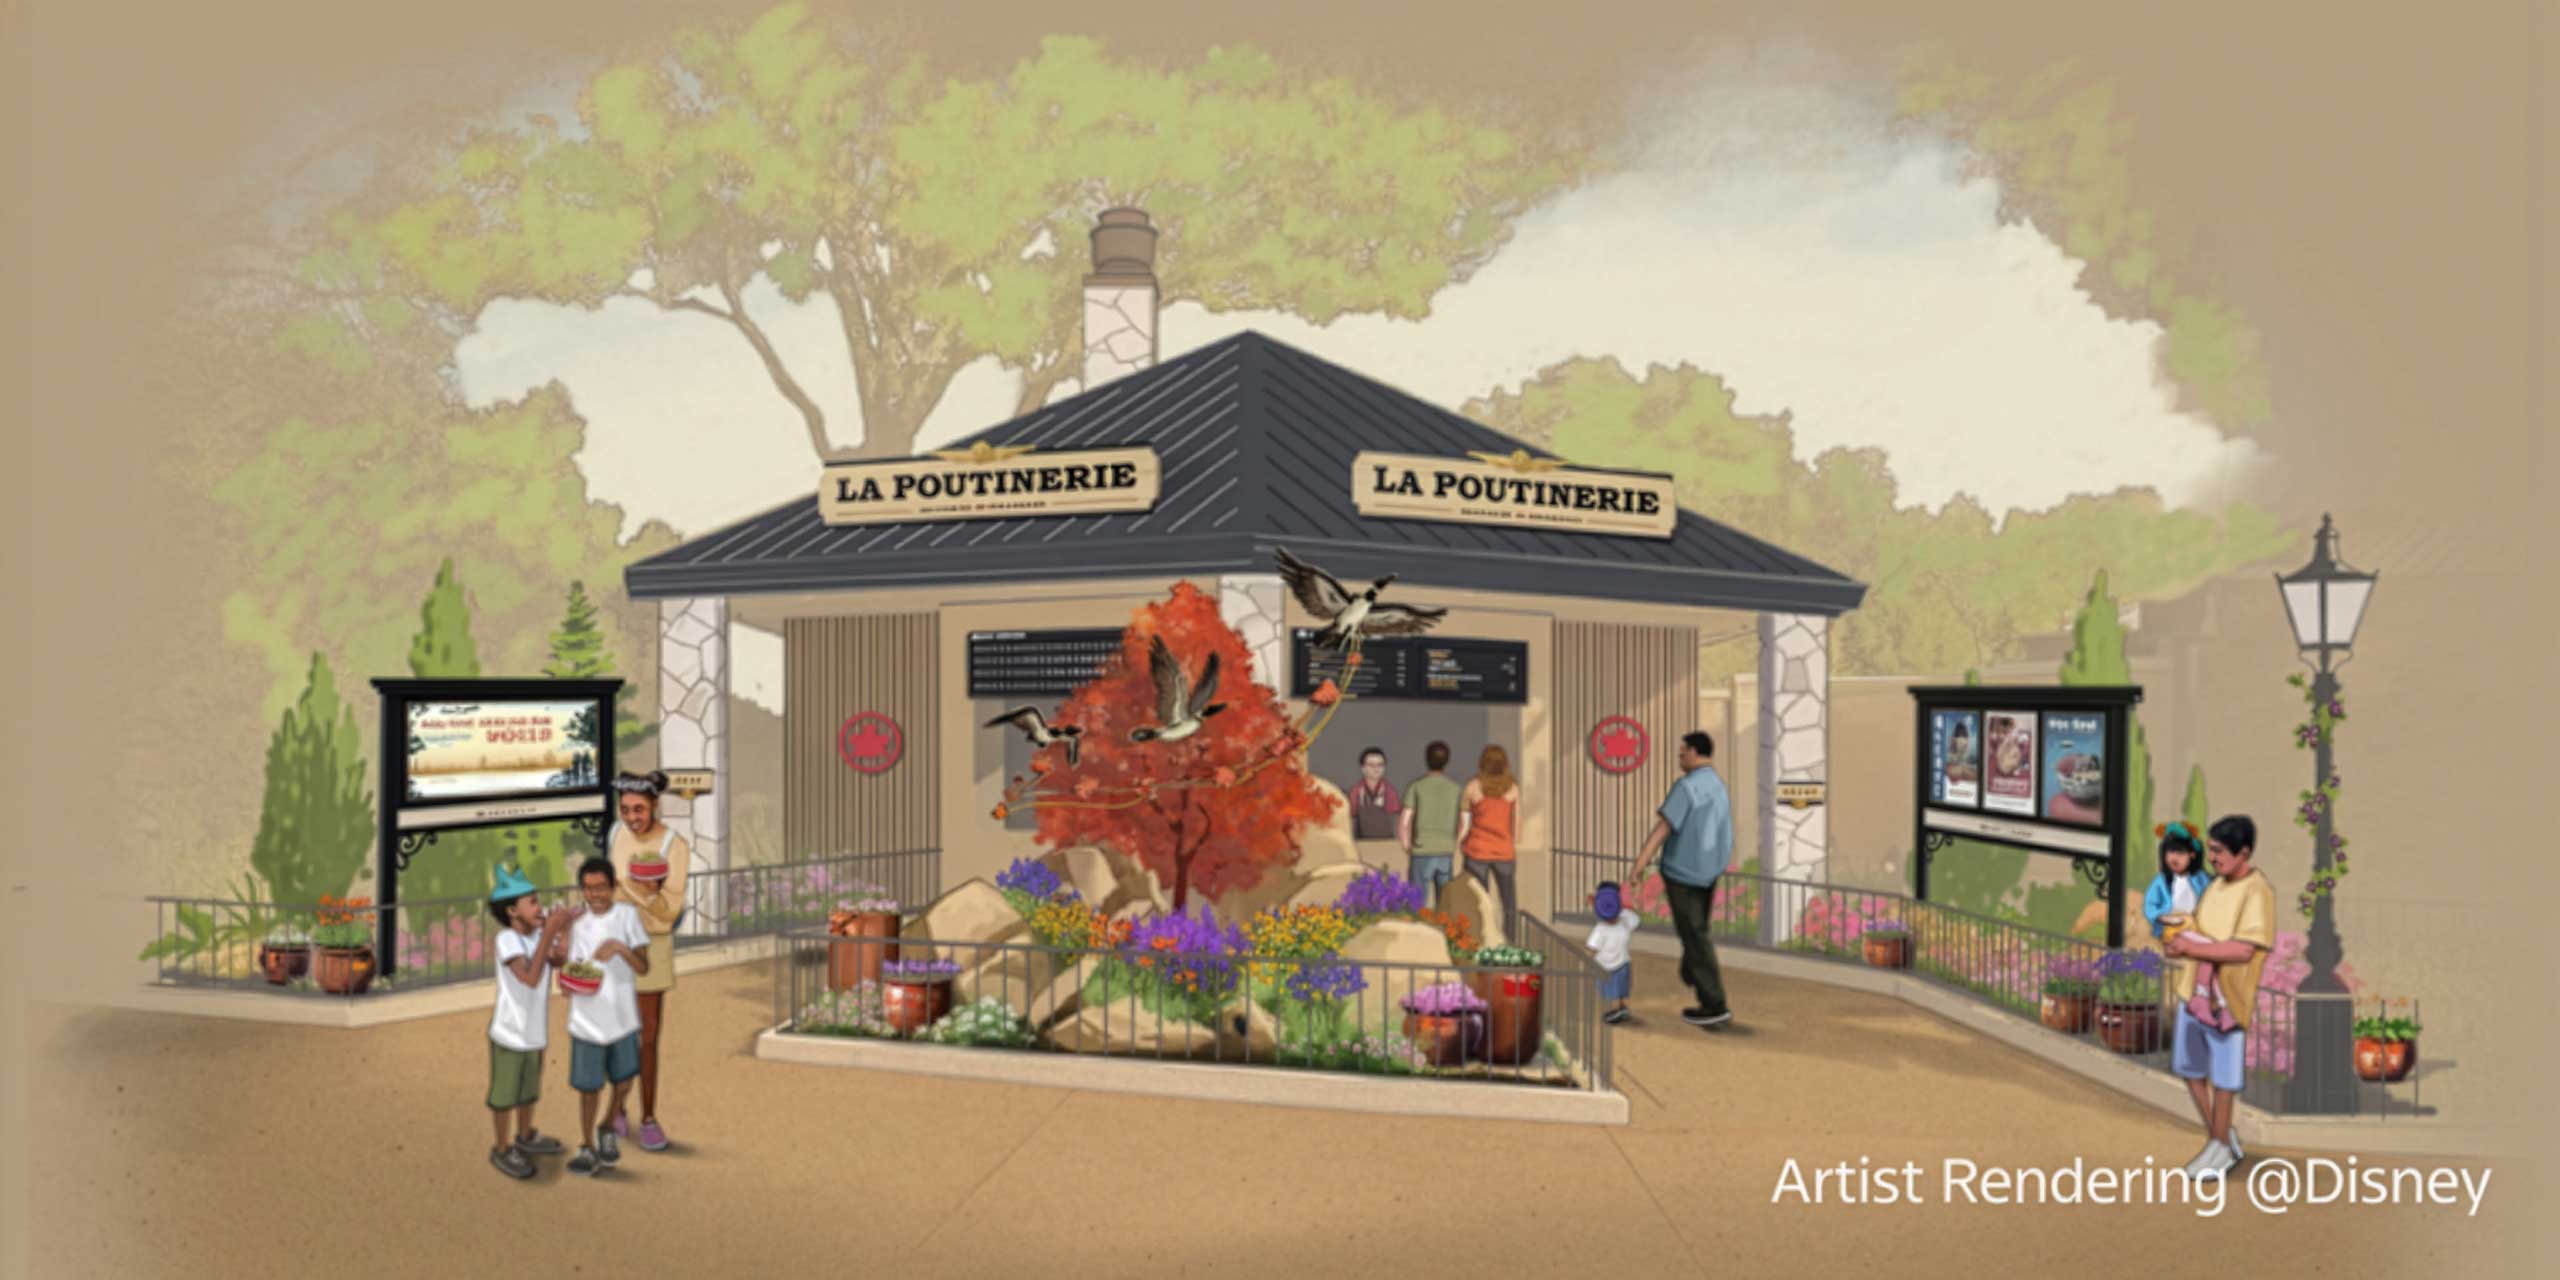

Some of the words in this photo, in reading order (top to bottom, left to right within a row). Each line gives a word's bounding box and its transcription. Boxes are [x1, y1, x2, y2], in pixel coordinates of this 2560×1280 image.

[837, 478, 883, 502] LA
[894, 463, 1137, 499] POUTINERIE
[1373, 466, 1424, 495] LA
[1434, 472, 1660, 515] POUTINERIE
